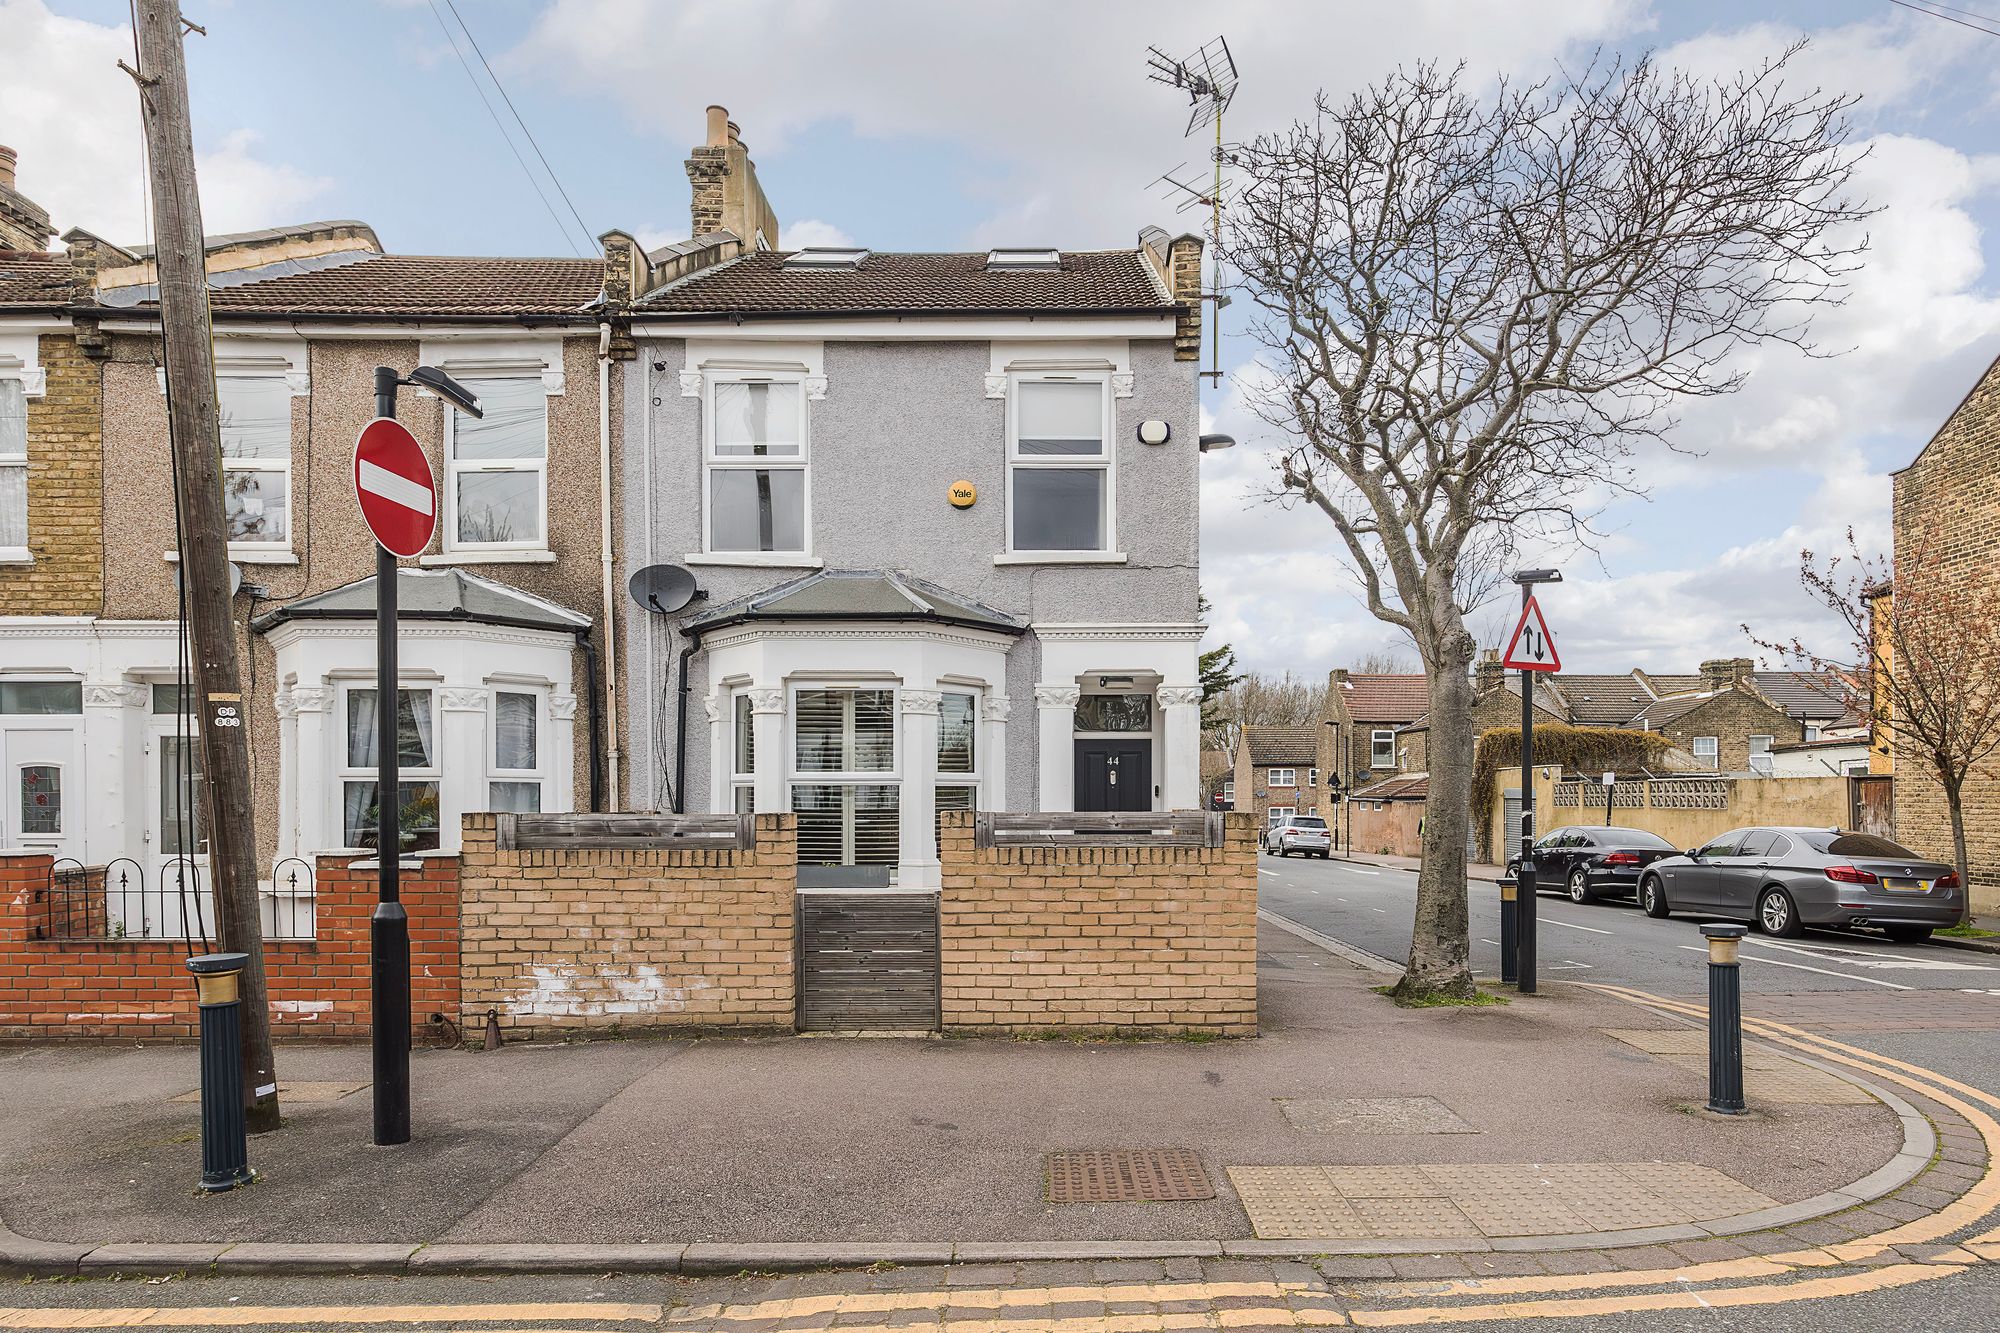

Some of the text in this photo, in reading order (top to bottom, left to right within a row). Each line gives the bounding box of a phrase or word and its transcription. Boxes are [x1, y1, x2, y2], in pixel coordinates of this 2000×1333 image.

[953, 489, 972, 498] Yale
[219, 708, 235, 716] DP
[217, 718, 239, 726] 883
[1107, 756, 1119, 765] 44
